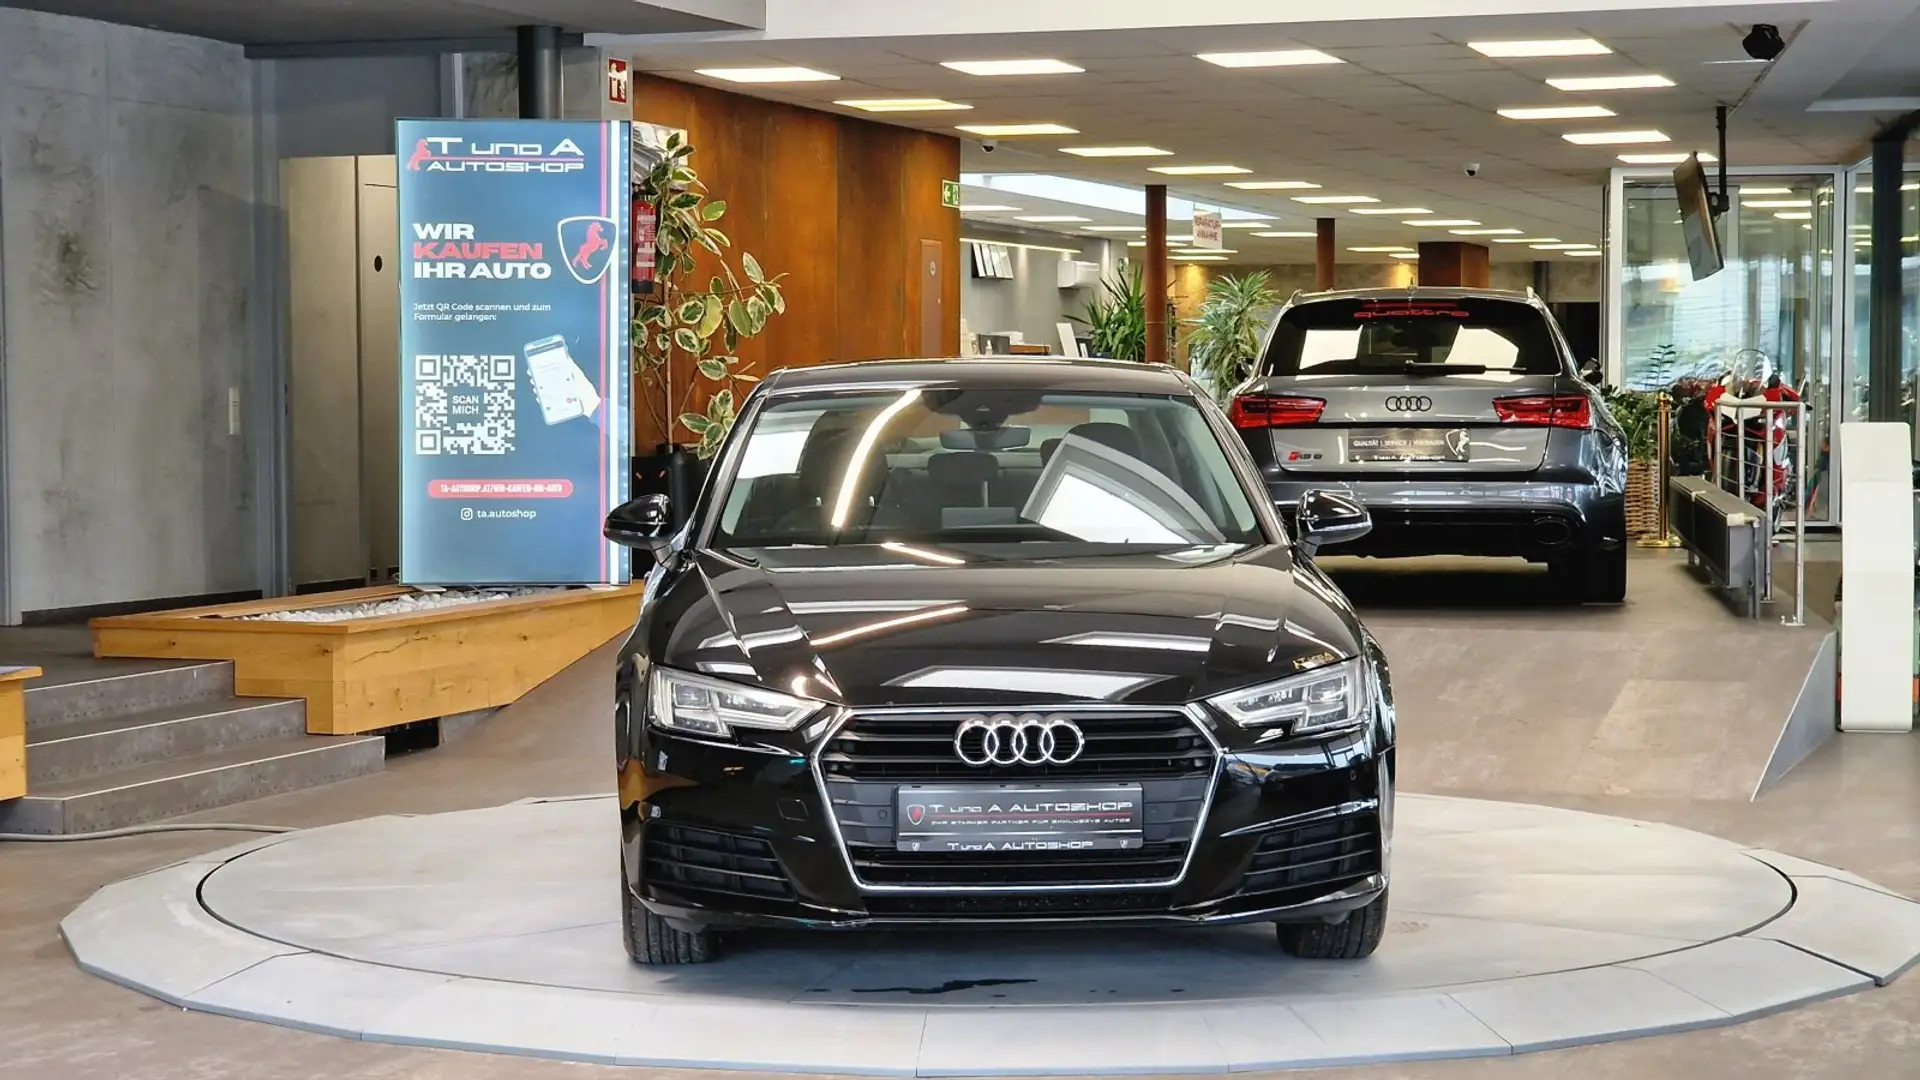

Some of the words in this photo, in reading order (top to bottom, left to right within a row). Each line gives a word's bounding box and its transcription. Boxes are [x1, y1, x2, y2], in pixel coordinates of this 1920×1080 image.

[426, 136, 463, 155] T
[549, 138, 585, 156] A
[426, 160, 585, 173] AUTOSHOP
[412, 223, 475, 240] WIR
[413, 242, 543, 260] KAUFEN
[413, 262, 467, 279] IHR
[468, 262, 552, 279] AUTO
[413, 302, 434, 311] Jetzt
[436, 303, 450, 312] QR
[451, 302, 474, 311] Code
[513, 302, 531, 311] und
[413, 312, 453, 321] Formular
[1353, 309, 1470, 318] quattro
[452, 395, 479, 405] SCAN
[452, 405, 479, 415] MICH
[477, 508, 537, 520] ta.autoshop
[928, 804, 945, 813] T
[987, 803, 1003, 813] A
[1009, 801, 1133, 813] AUTOSHOP
[946, 842, 960, 851] T
[983, 842, 996, 851] A
[1001, 841, 1094, 851] AUTOSHOP
